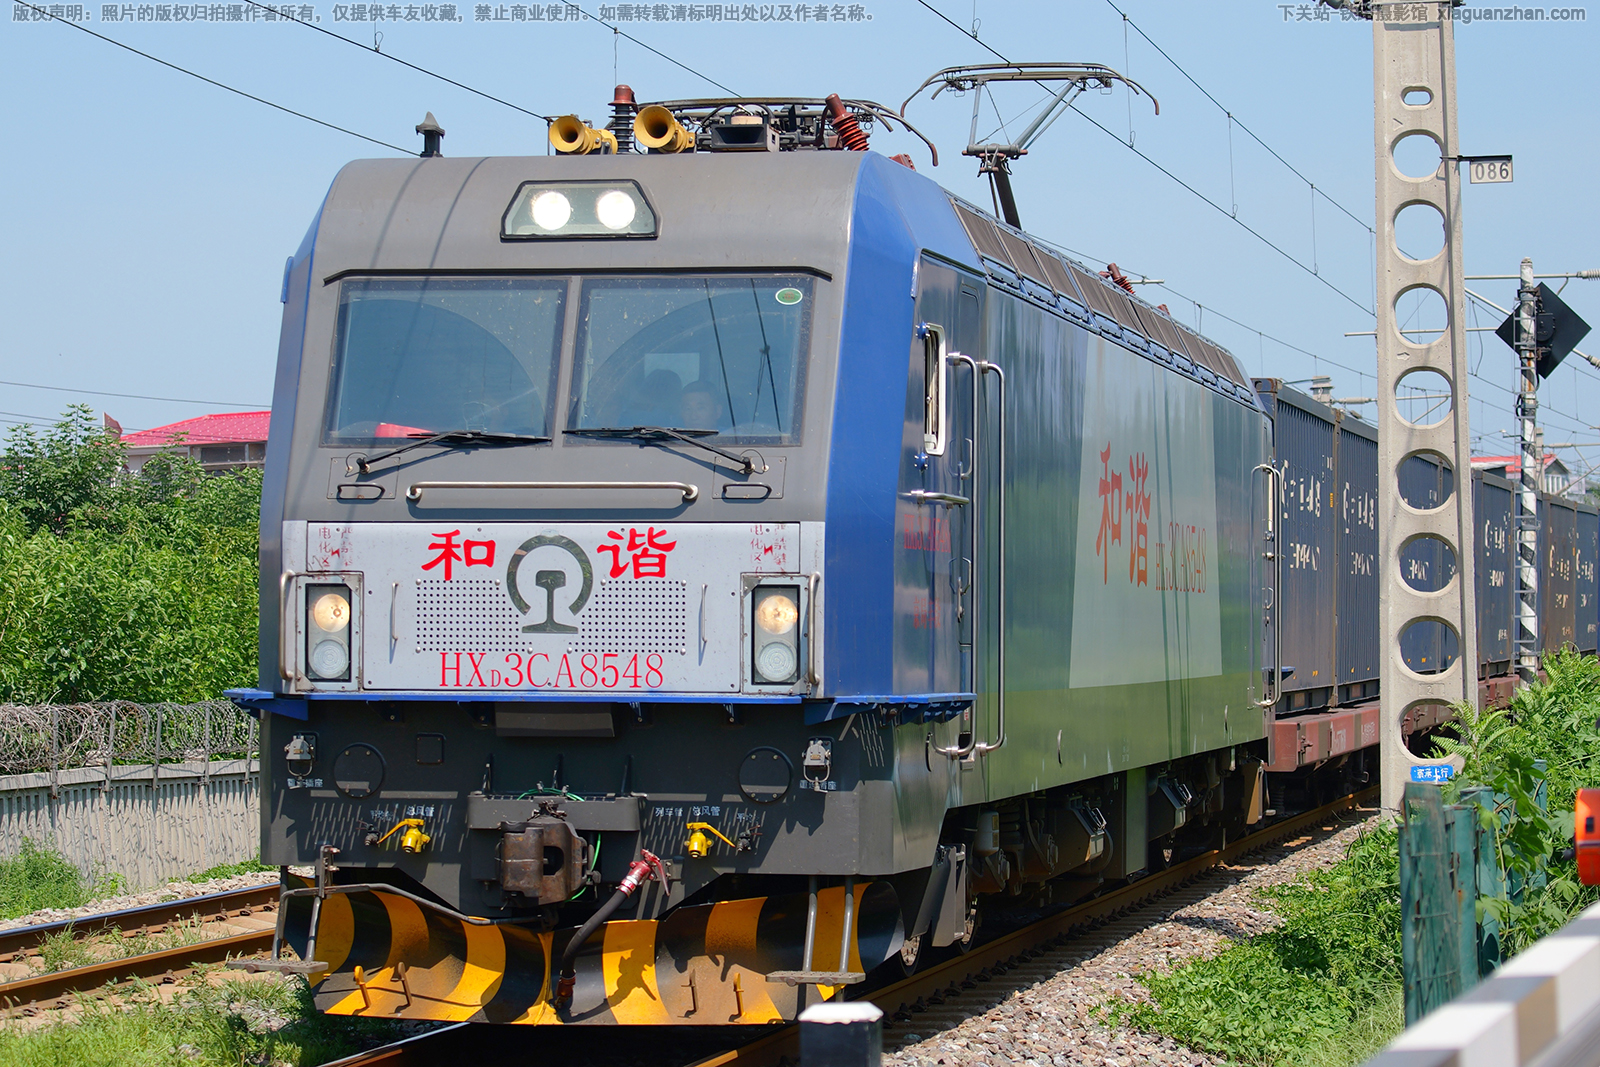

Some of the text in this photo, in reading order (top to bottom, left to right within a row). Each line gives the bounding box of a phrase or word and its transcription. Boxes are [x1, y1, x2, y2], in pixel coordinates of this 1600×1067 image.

[1474, 162, 1509, 180] 086
[1095, 440, 1151, 587] 和谐
[421, 526, 677, 581] 和 谐
[439, 652, 664, 690] HXD3CA8548
